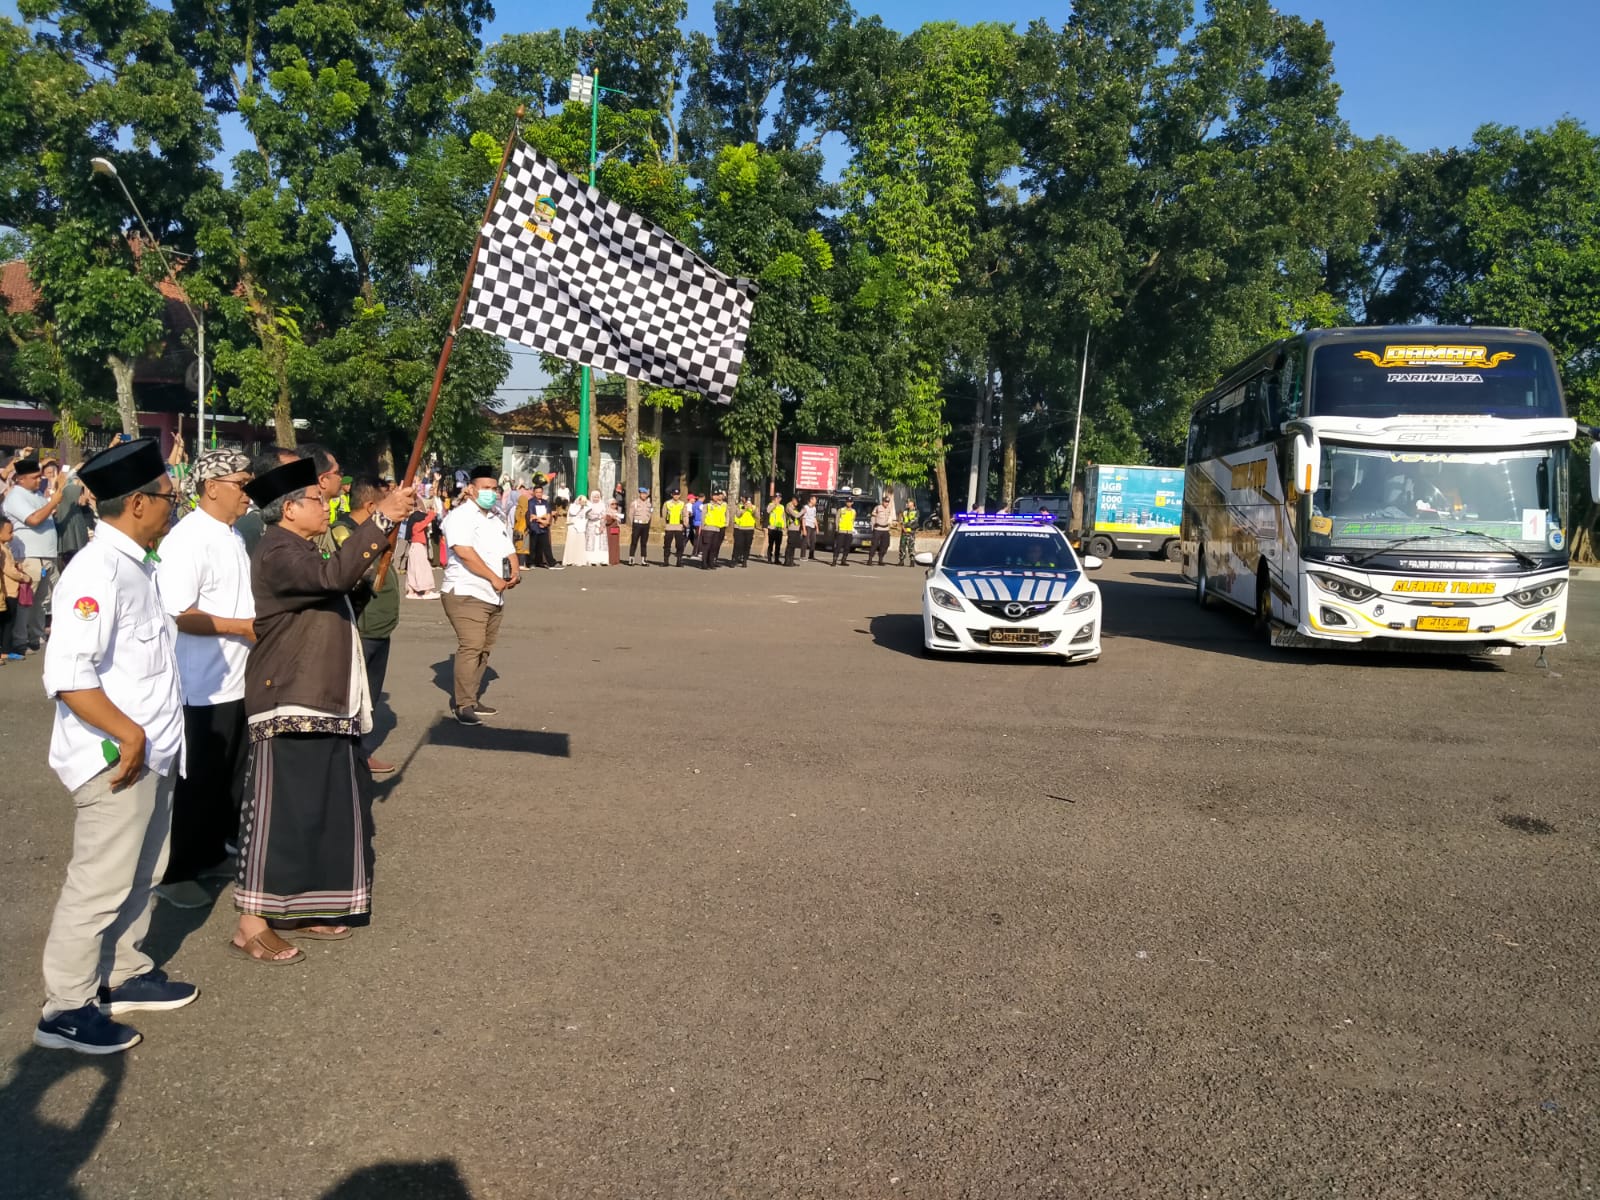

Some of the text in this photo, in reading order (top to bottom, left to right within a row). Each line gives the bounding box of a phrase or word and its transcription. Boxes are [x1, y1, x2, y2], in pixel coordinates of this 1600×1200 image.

[1385, 345, 1486, 361] DAMAR
[1387, 373, 1484, 383] PARIWISATA
[957, 570, 1066, 579] POLISI
[1392, 580, 1496, 594] ALFARIZ TRANS
